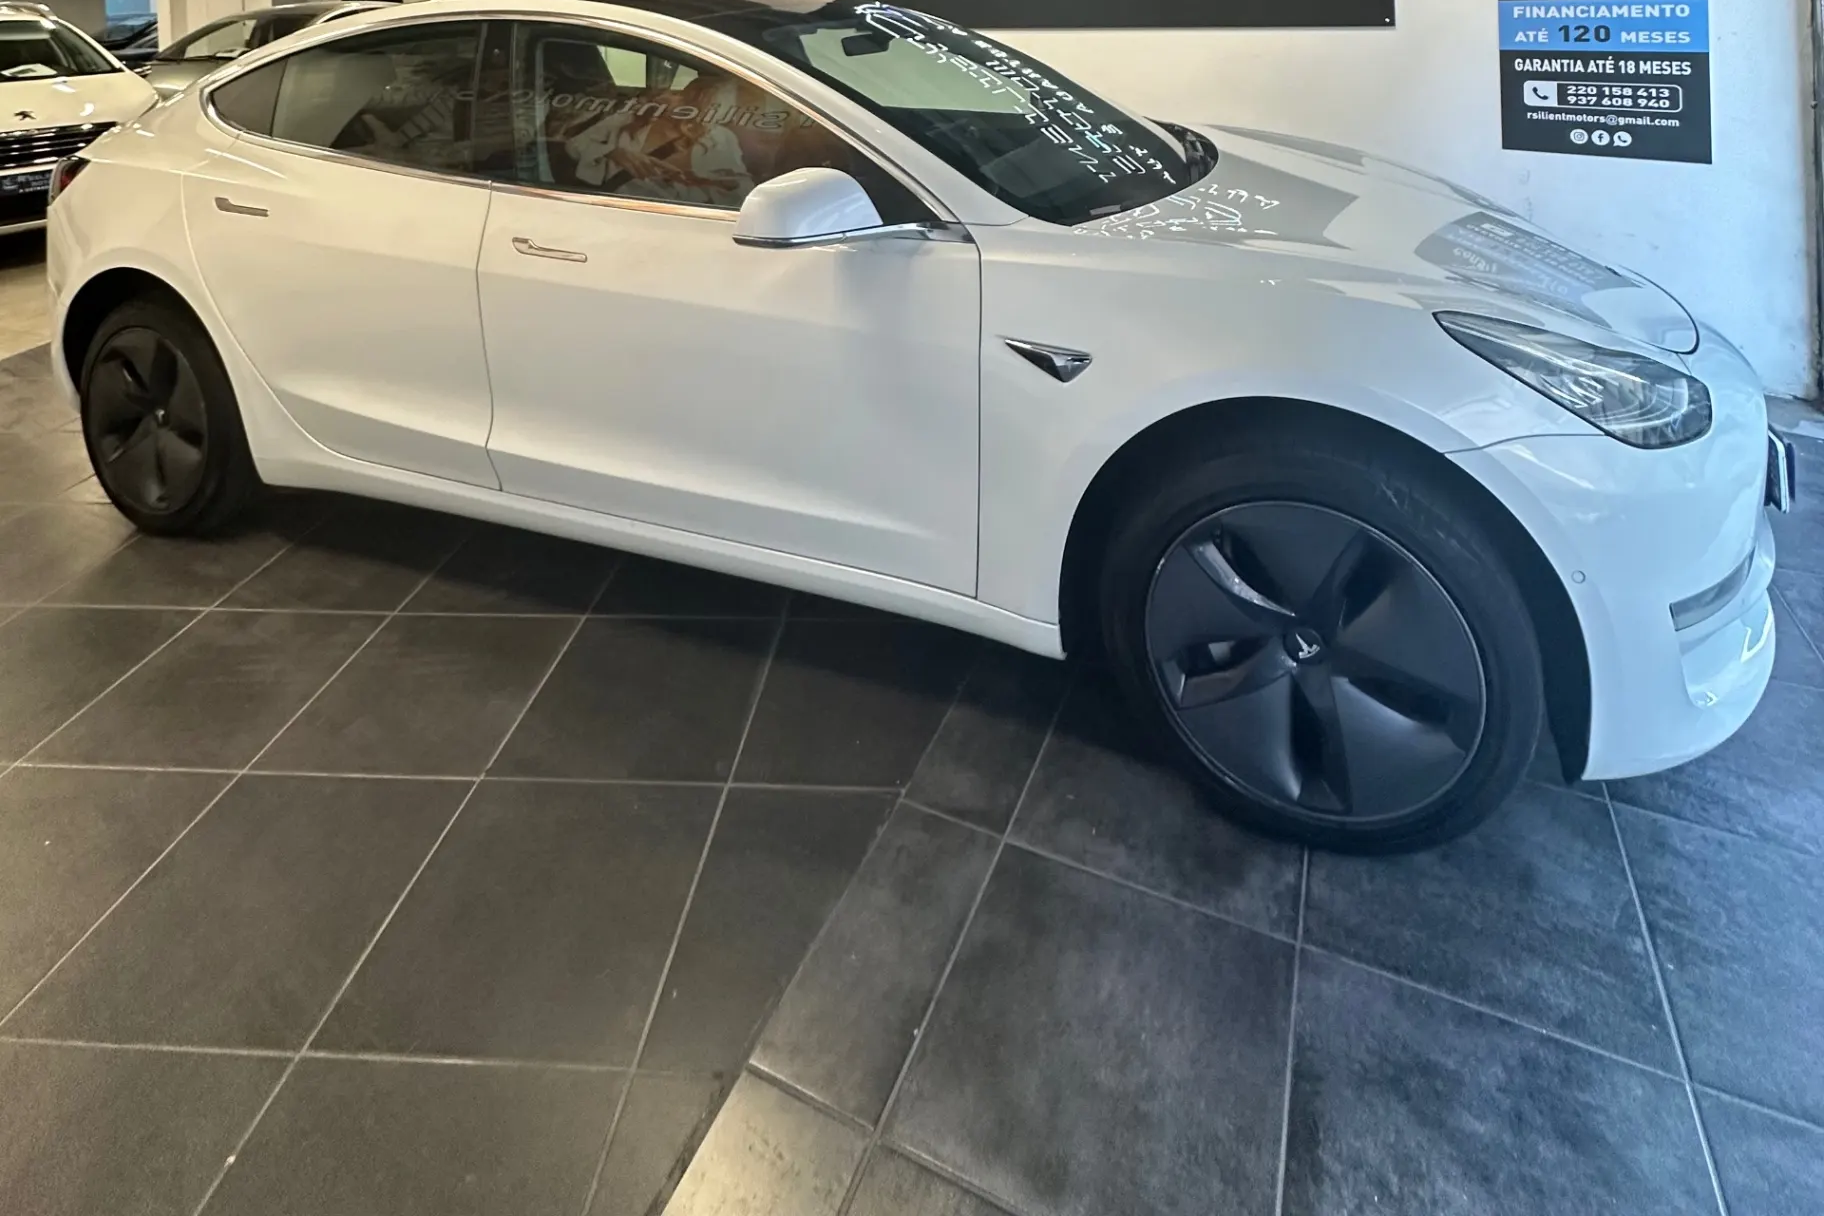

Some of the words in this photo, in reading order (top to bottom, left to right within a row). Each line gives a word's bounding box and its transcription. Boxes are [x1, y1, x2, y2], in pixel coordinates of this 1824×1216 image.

[1512, 4, 1691, 19] FINANCIAMENTO
[1514, 28, 1549, 43] ATÉ
[1558, 24, 1611, 43] 120
[1620, 31, 1691, 44] MESES
[1514, 58, 1585, 73] GARANTIA
[1587, 56, 1615, 74] ATÉ
[1618, 60, 1636, 75] 18
[1639, 61, 1692, 76] MESES
[1566, 85, 1597, 95] 220
[1602, 86, 1633, 96] 158
[1636, 88, 1670, 98] 413
[1566, 95, 1597, 105] 937
[1601, 97, 1633, 106] 608
[1637, 98, 1670, 108] 940
[1526, 110, 1680, 127] rsilientmotors@gmail.com
